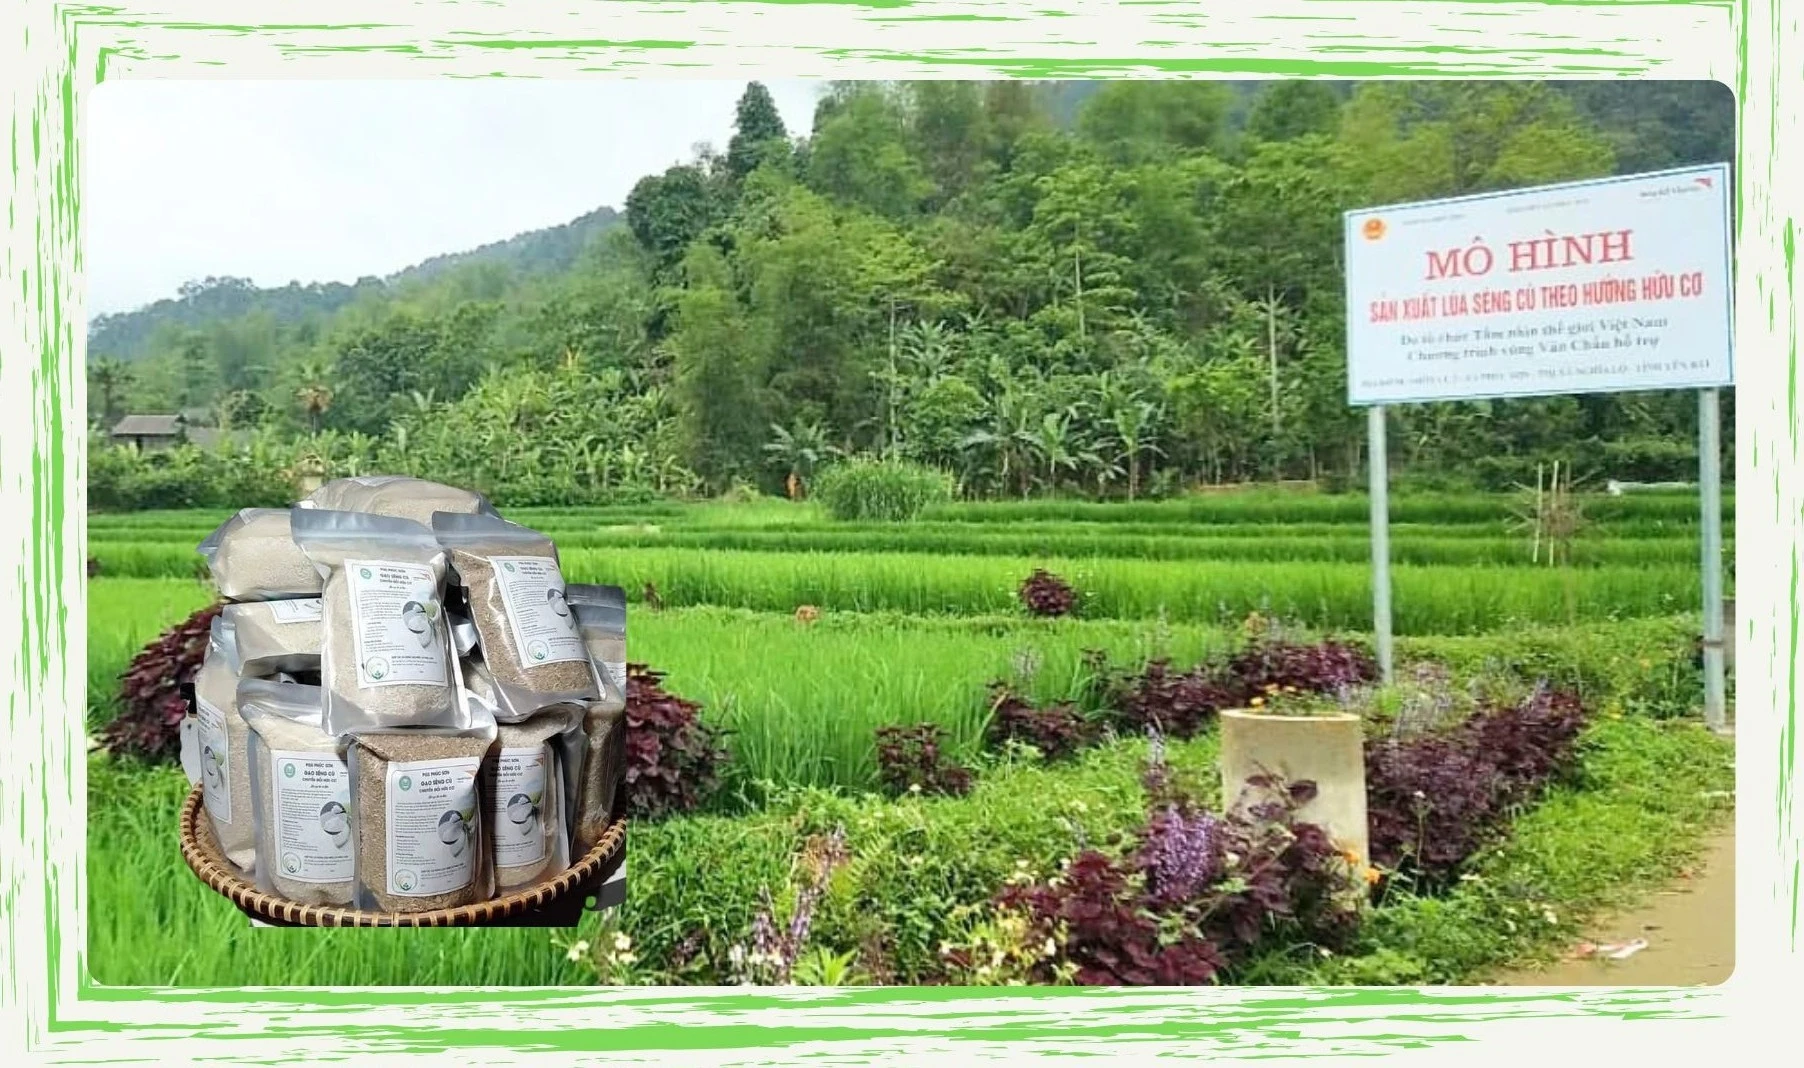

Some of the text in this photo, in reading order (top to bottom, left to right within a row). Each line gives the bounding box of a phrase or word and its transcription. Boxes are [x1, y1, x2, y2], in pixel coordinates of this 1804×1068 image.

[1425, 229, 1634, 280] MÔ HÌNH
[1370, 292, 1398, 323] SẢN
[1402, 289, 1437, 321] XUẤT
[1442, 290, 1468, 317] LÚA
[1541, 283, 1577, 309] THEO
[1582, 273, 1637, 306] HƯỚNG
[1643, 269, 1675, 301] HỮU
[1680, 271, 1703, 297] CƠ
[1600, 317, 1628, 332] Việt
[1632, 316, 1668, 328] Nam
